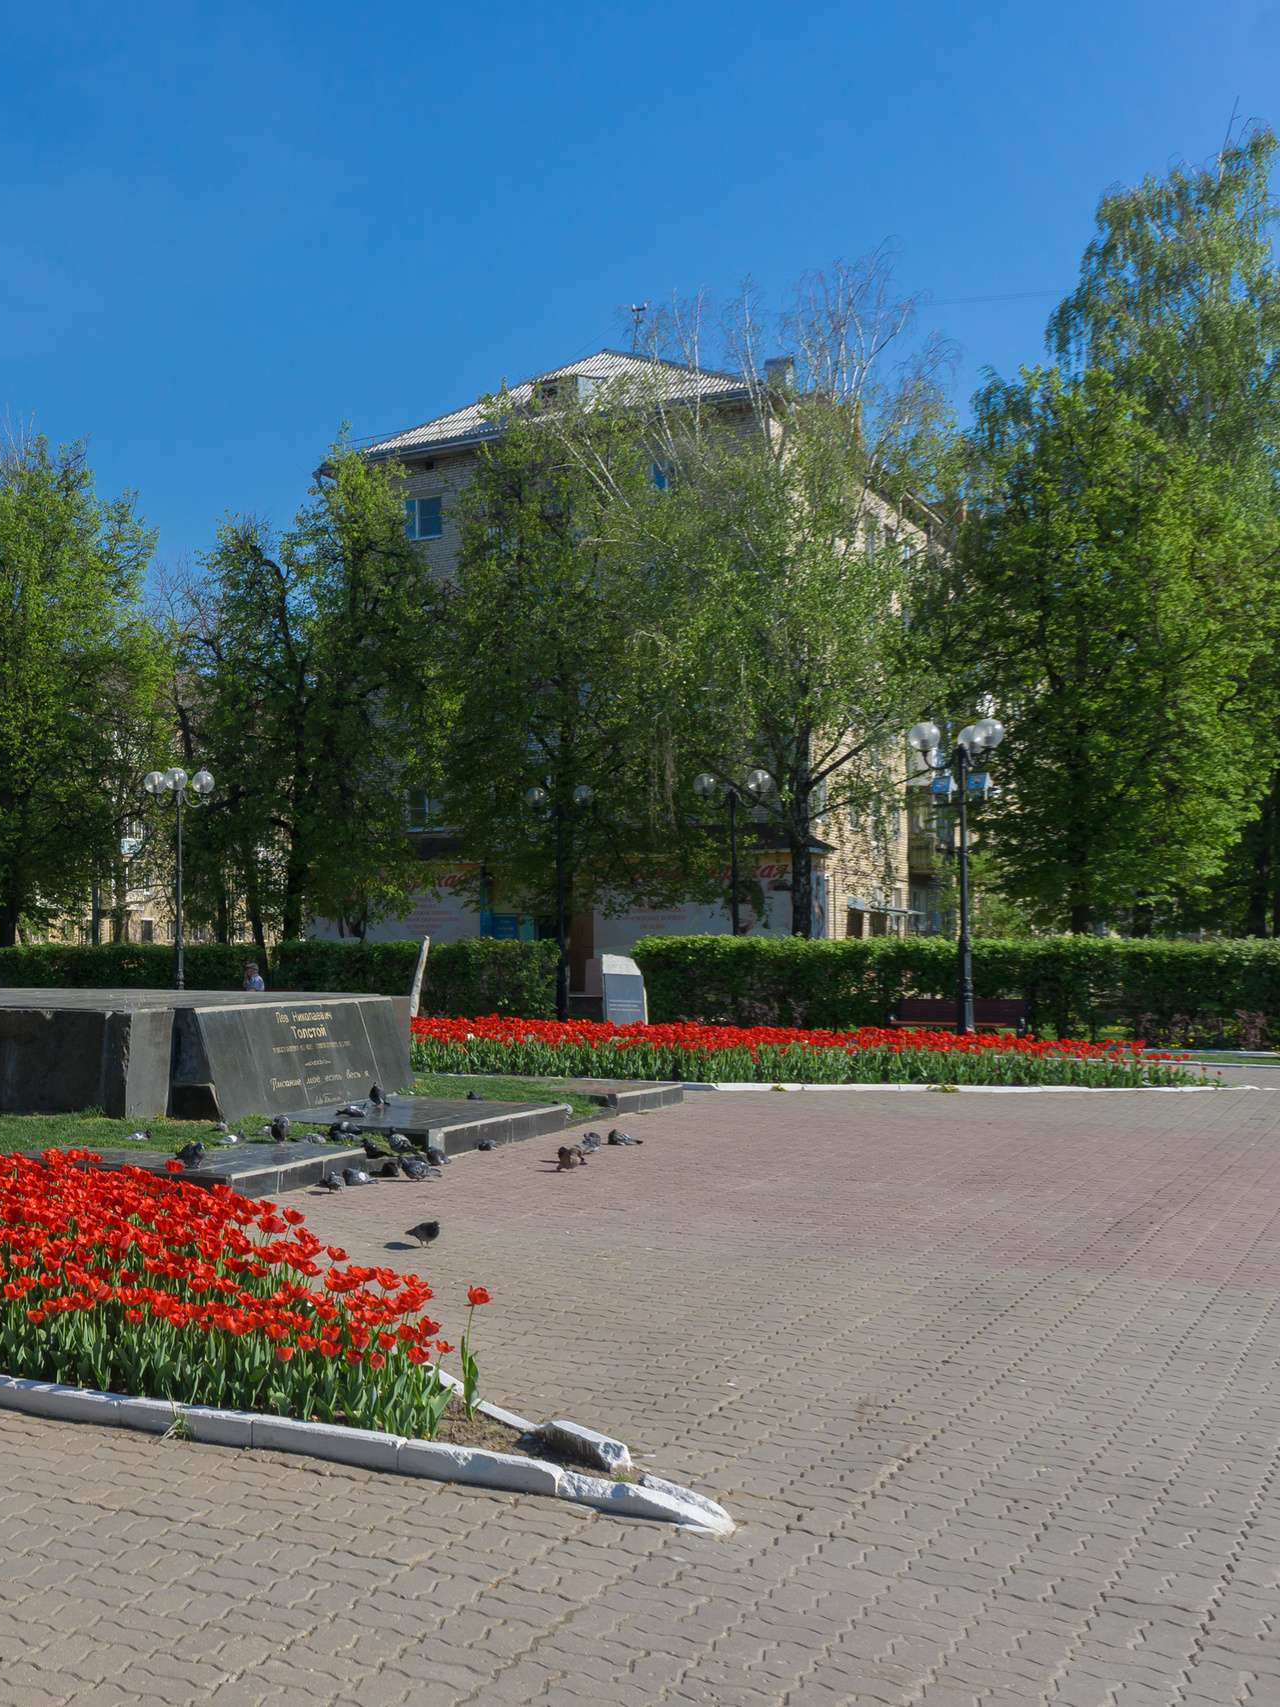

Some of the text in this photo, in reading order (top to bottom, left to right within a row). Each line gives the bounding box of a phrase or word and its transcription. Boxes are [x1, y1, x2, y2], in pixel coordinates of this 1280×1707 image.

[275, 1010, 333, 1024] Лев Николаевич
[290, 1023, 328, 1039] Толстой
[269, 1077, 301, 1091] Писание
[324, 1073, 342, 1082] есть
[346, 1068, 361, 1079] весь
